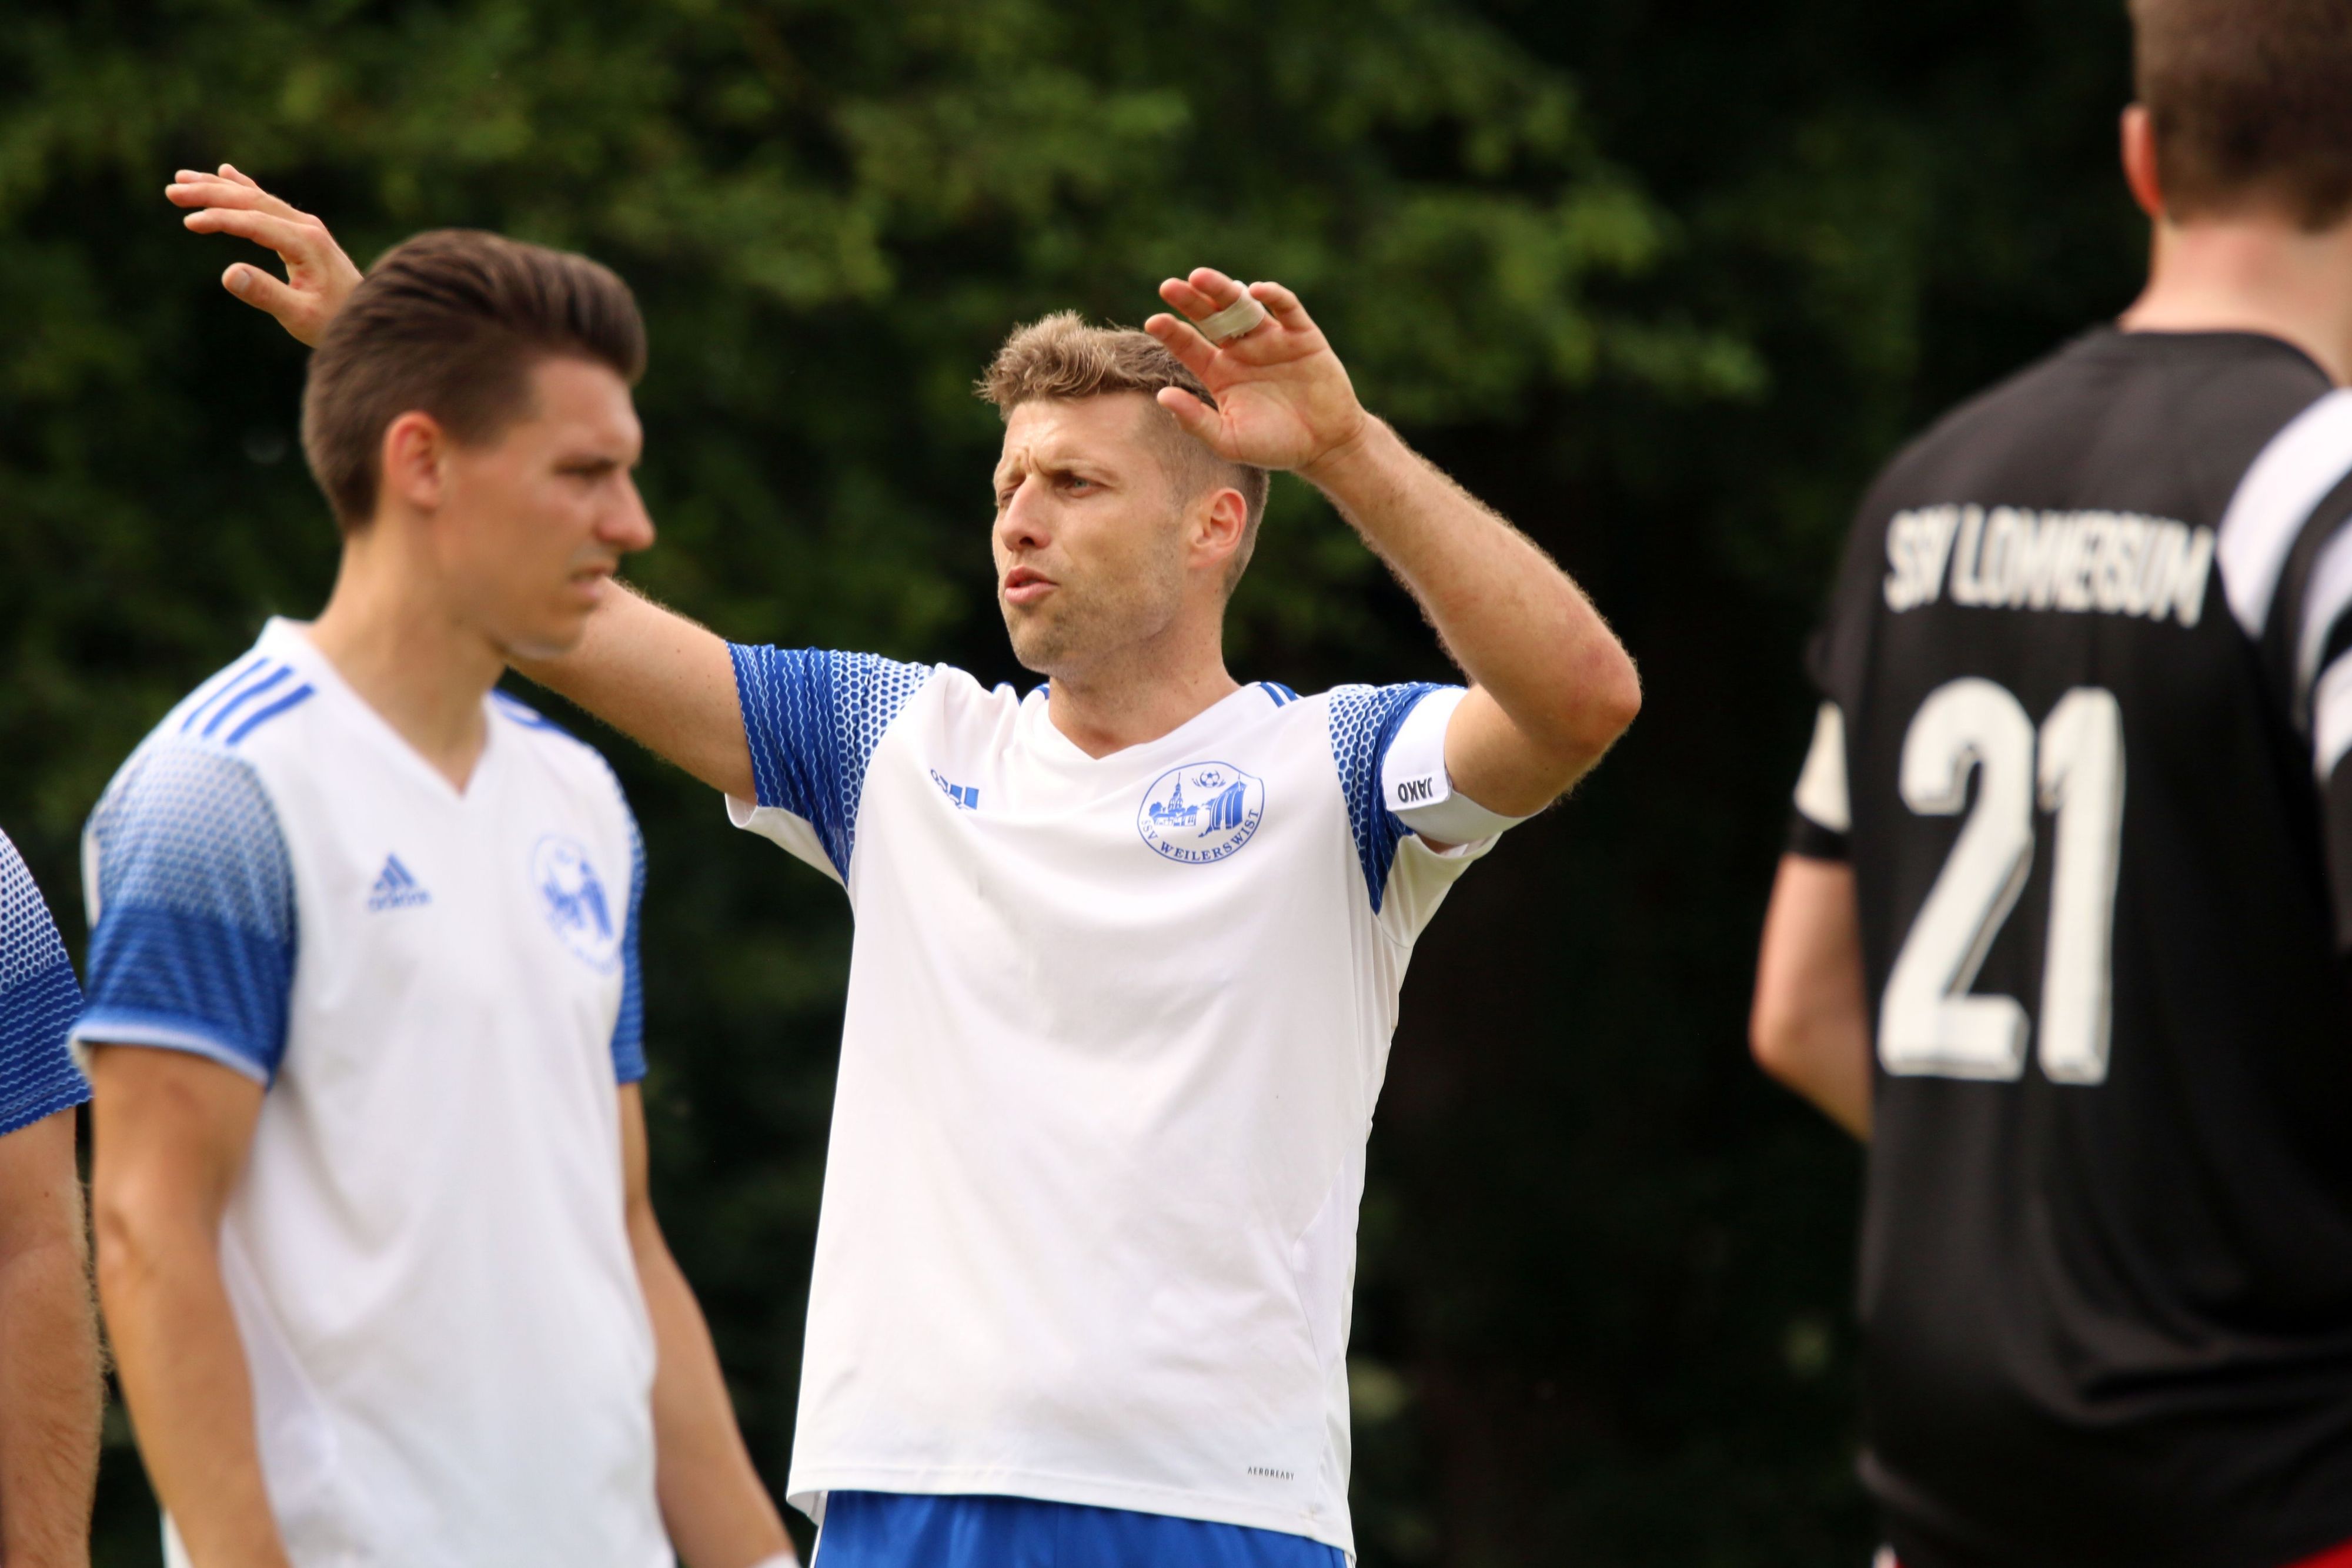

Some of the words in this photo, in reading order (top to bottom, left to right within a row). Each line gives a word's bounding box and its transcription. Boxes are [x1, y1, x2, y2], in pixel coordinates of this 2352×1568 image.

[1398, 777, 1433, 803] JAKO
[1160, 809, 1259, 861] WEILERSWIST
[1879, 677, 2126, 1085] 21
[1248, 1466, 1294, 1480] AEROREADY
